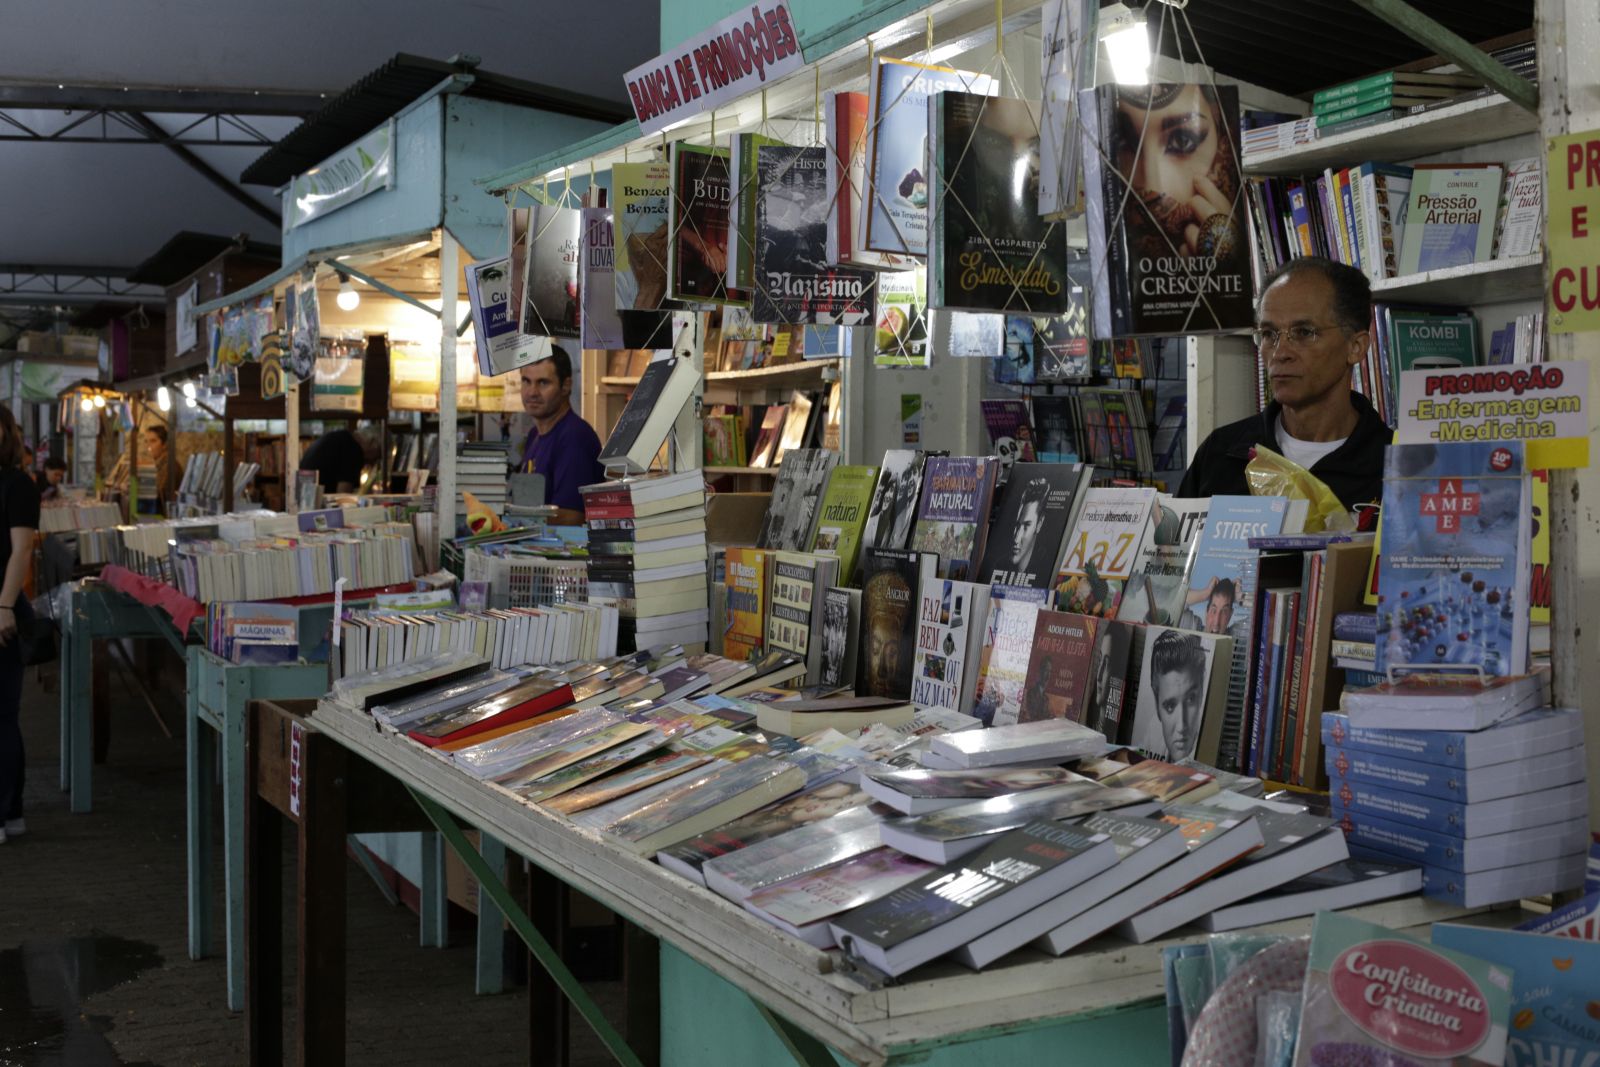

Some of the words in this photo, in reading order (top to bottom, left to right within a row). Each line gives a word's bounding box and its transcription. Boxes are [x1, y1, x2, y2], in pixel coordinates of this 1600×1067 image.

[629, 65, 682, 123] BANCA
[675, 54, 702, 104] DE
[693, 5, 797, 95] PROMOÇÕES
[1446, 181, 1480, 190] CONTROLE
[1418, 193, 1477, 211] Pressão
[1425, 208, 1482, 224] Arterial
[1572, 205, 1588, 239] E
[992, 238, 1048, 251] GASPARETTO
[959, 251, 1061, 296] Esmeralda
[1139, 257, 1153, 274] O
[1156, 255, 1217, 277] QUARTO
[491, 291, 507, 304] Cu
[767, 270, 863, 302] Nazismo
[1140, 274, 1243, 296] CRESCENTE
[1409, 326, 1460, 340] KOMBI
[1425, 365, 1564, 396] PROMOÇÃO
[1408, 394, 1582, 421] -Enfermagem
[1430, 417, 1556, 442] -Medicina
[823, 501, 862, 523] natural
[929, 492, 969, 510] NATURAL
[1212, 520, 1269, 541] STRESS
[1063, 531, 1089, 569] A
[1091, 540, 1110, 571] a
[1107, 533, 1136, 573] Z
[921, 597, 941, 623] FAZ
[919, 624, 941, 652] BEM
[1048, 624, 1066, 636] ADOLF
[1066, 627, 1084, 638] HITLER
[946, 659, 961, 685] OU
[1255, 651, 1266, 700] CRIANÇA
[1289, 655, 1303, 713] MASTOLOGIA
[913, 678, 931, 706] FAZ
[1250, 703, 1261, 751] QUEIMADA
[1023, 821, 1047, 838] LEE
[1045, 828, 1094, 849] CHILD
[1083, 815, 1115, 832] LEE
[1108, 820, 1162, 839] CHILD
[1345, 951, 1484, 1013] Confeitaria
[1363, 982, 1463, 1033] Criativa
